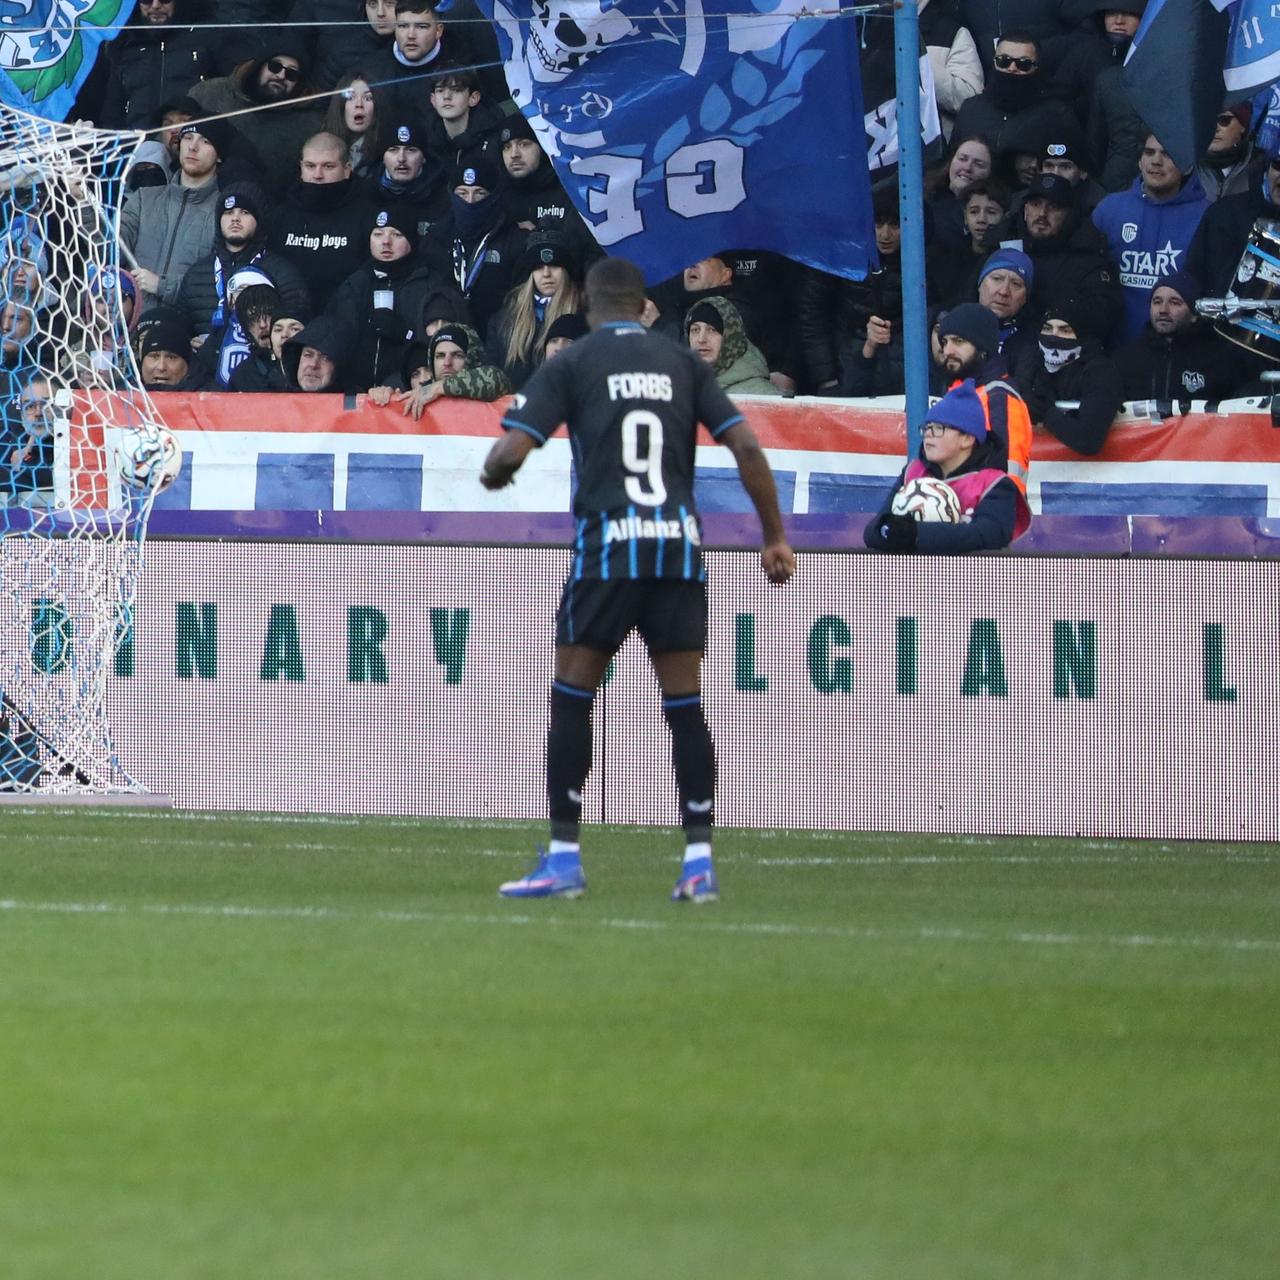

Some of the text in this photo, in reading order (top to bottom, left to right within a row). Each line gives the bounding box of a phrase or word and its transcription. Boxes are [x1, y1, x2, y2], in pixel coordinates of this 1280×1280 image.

[537, 204, 565, 219] Racing
[285, 233, 348, 249] Racing Boys
[1120, 249, 1171, 277] STAR
[1120, 275, 1159, 287] CASINO
[607, 372, 673, 402] FORBS
[621, 409, 668, 507] 9
[605, 516, 682, 544] Allianz
